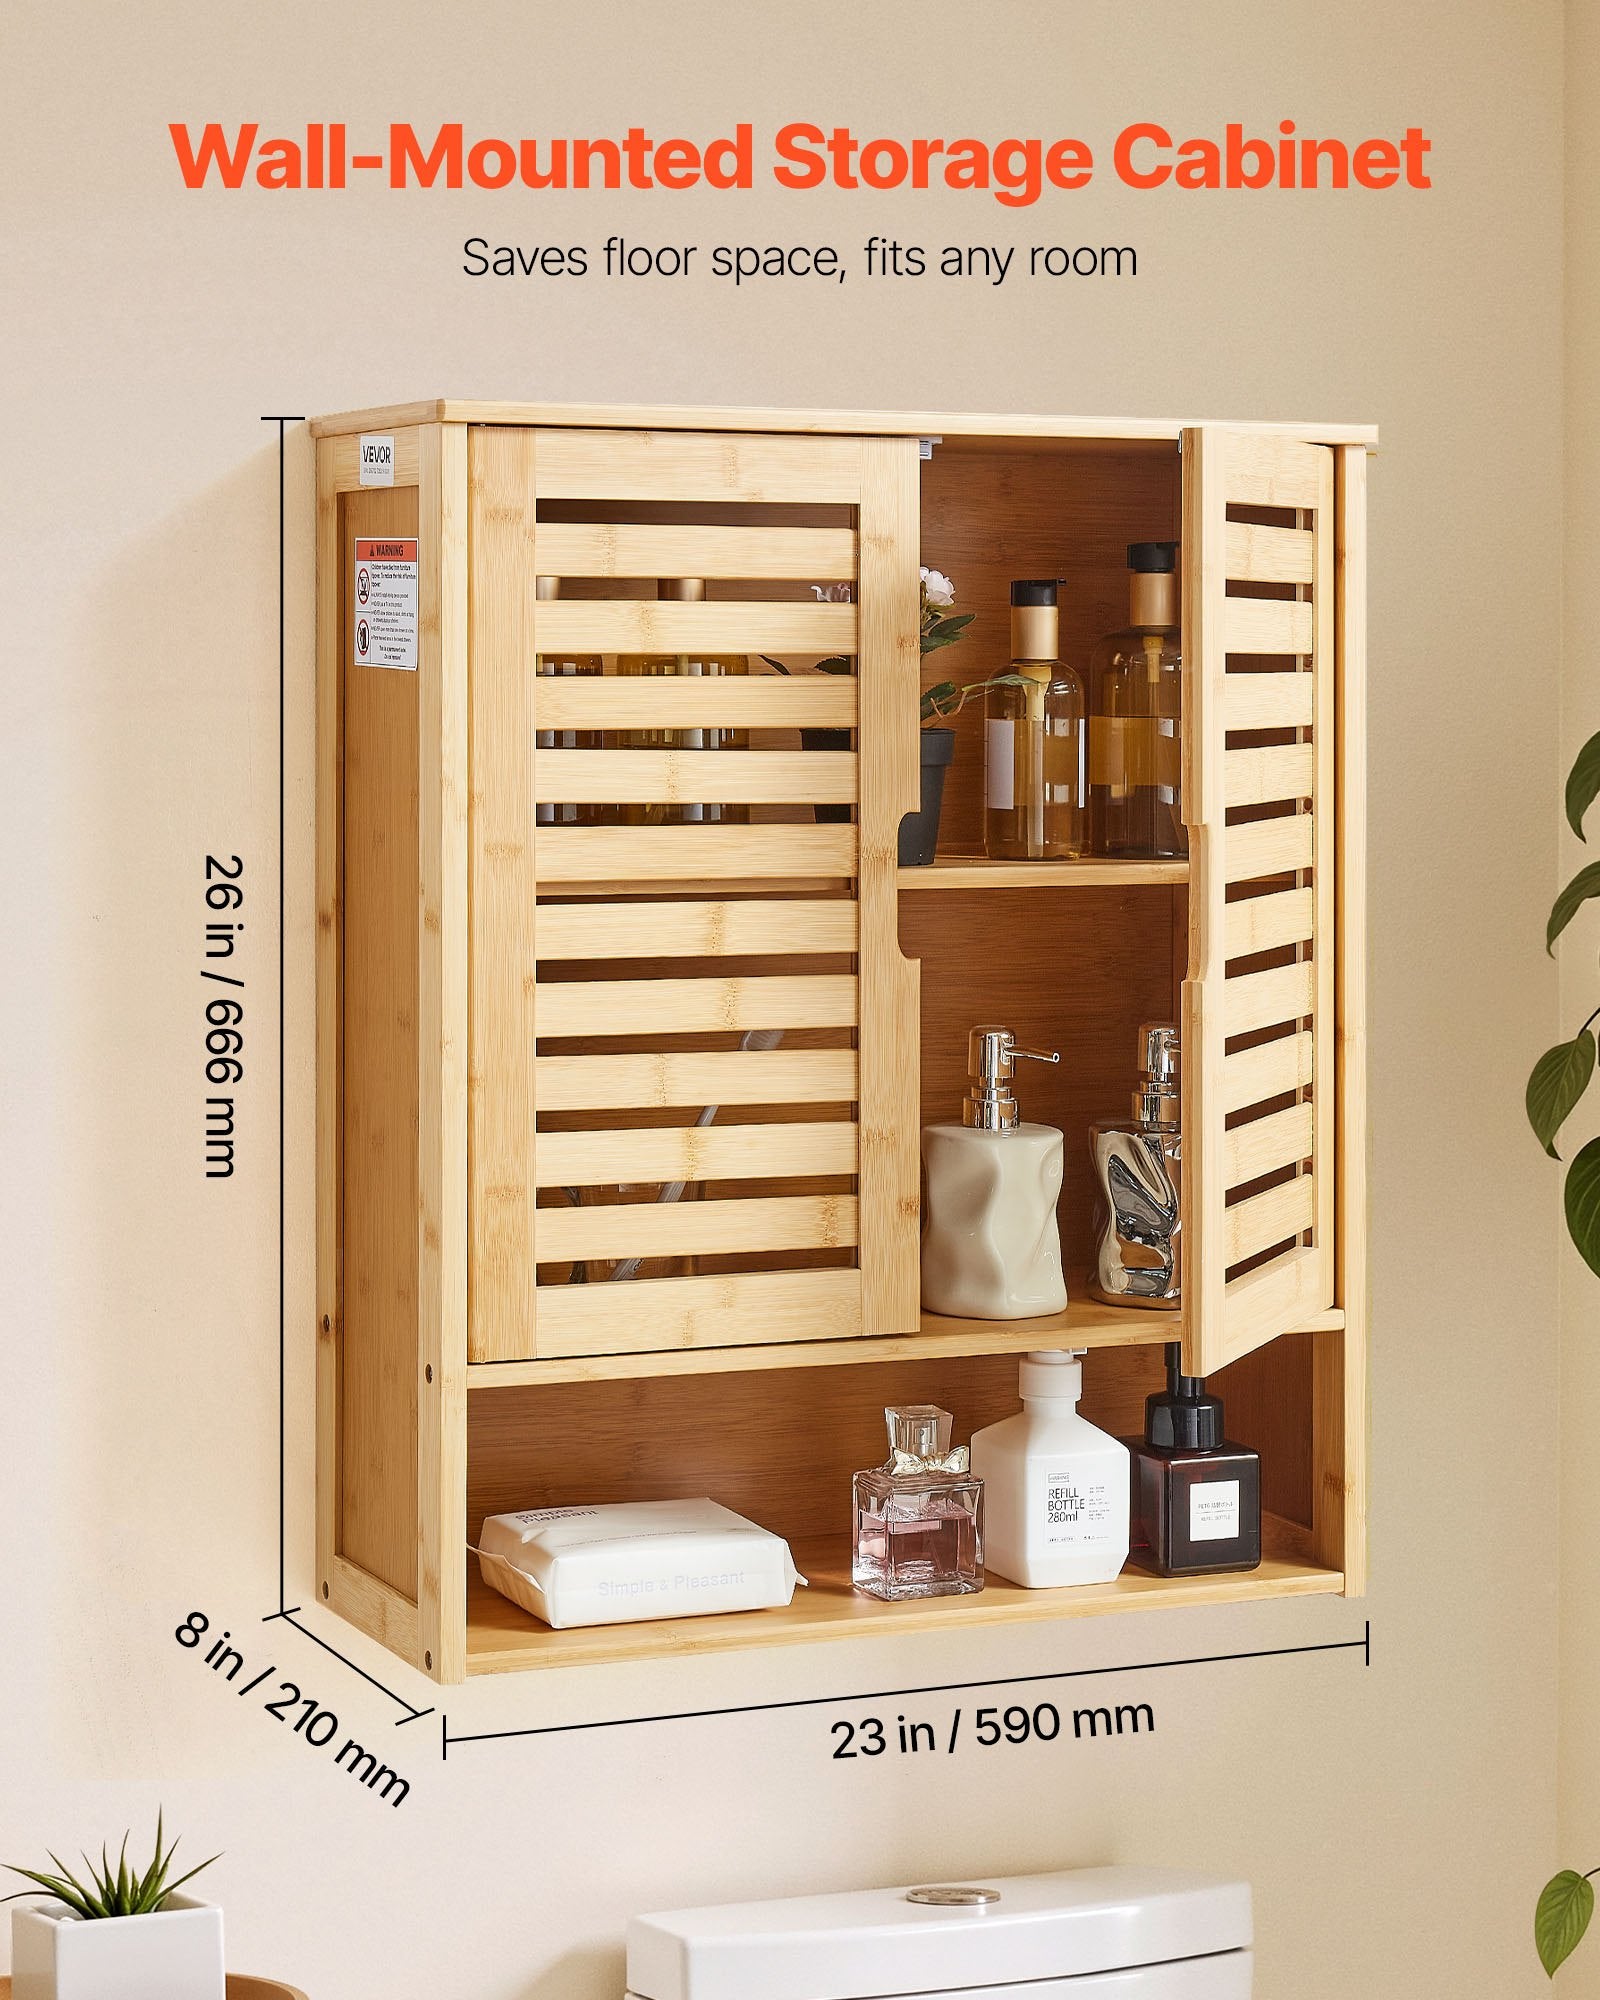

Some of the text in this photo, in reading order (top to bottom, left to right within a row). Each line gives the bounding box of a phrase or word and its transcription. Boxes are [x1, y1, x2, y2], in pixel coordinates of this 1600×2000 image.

[362, 445, 391, 464] VEVOR
[375, 544, 404, 557] WARNING
[1048, 1487, 1080, 1500] REFILL
[1048, 1498, 1086, 1512] BOTTLE
[1048, 1510, 1079, 1524] 280ml
[598, 1579, 654, 1597] Simple
[673, 1570, 745, 1589] Pleasant
